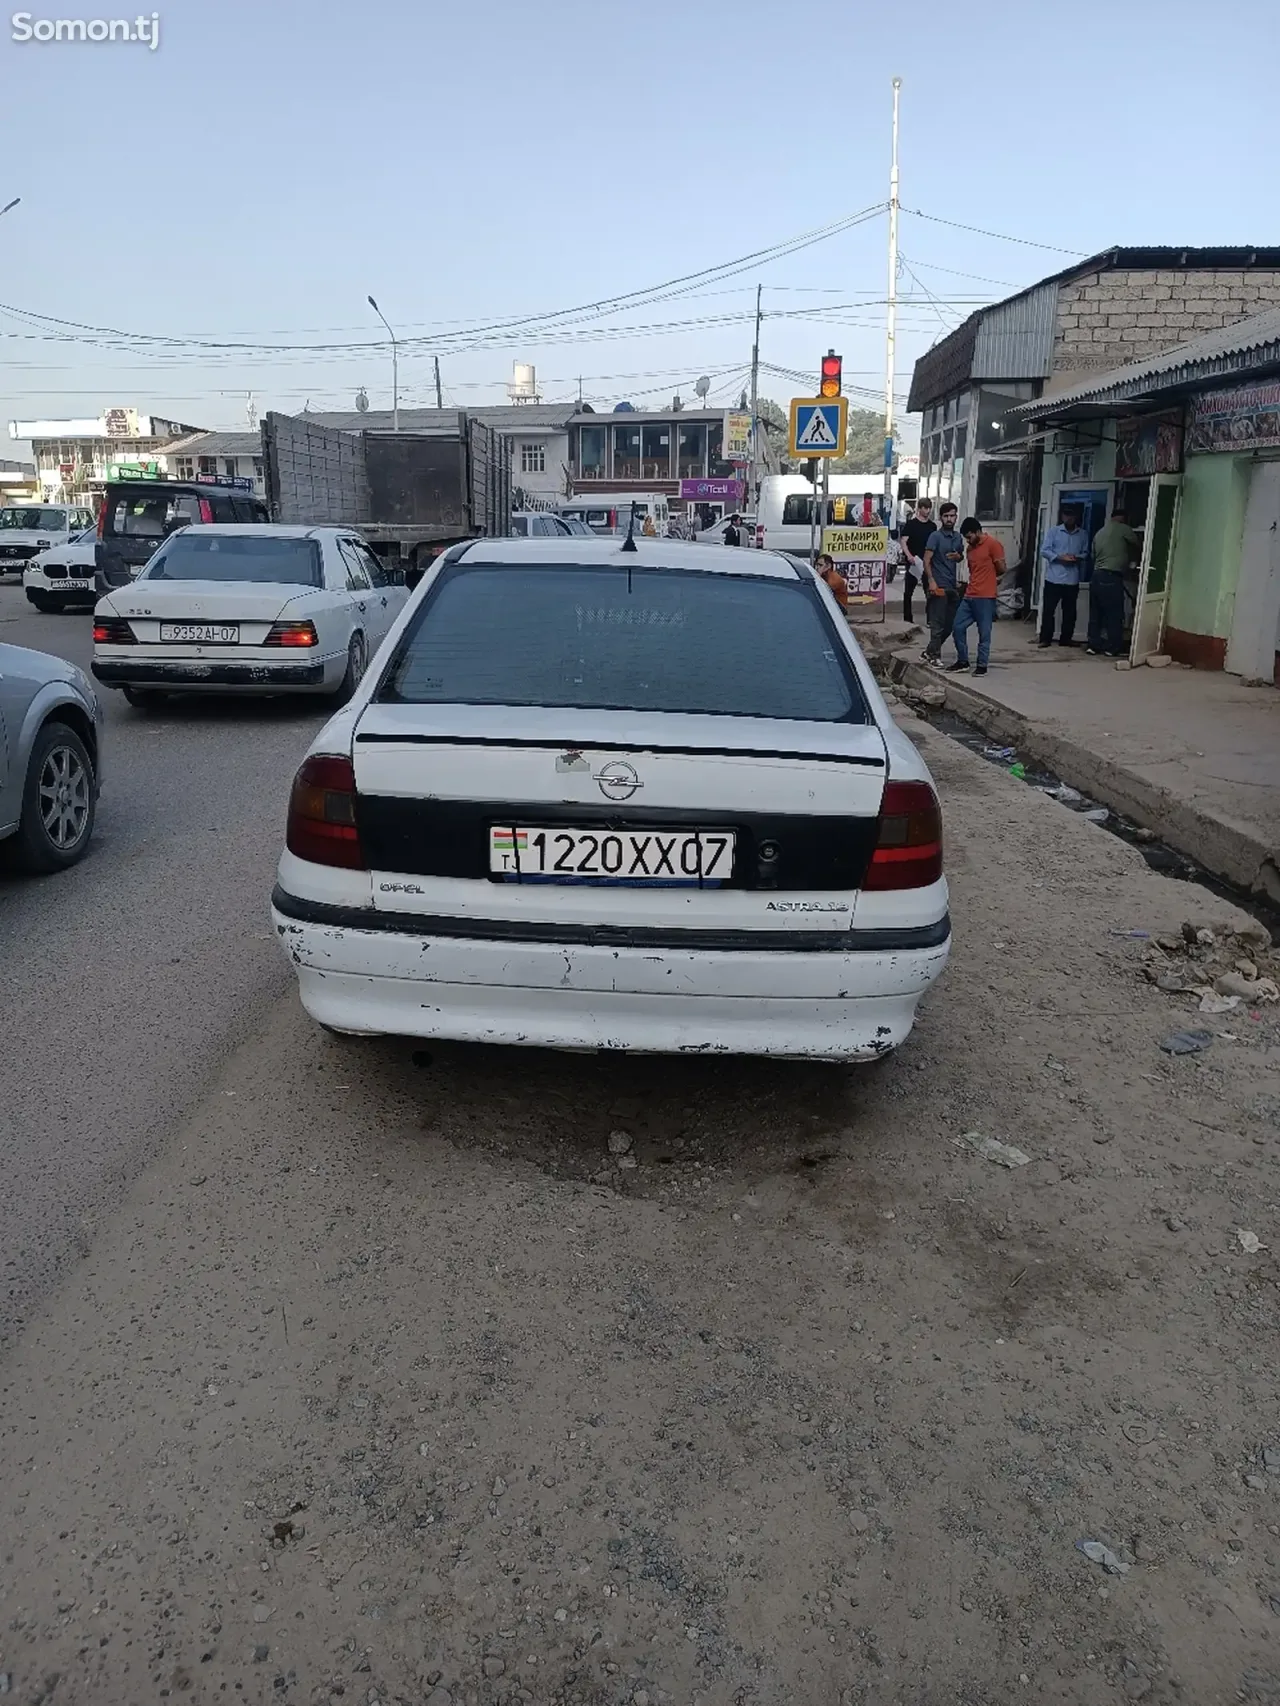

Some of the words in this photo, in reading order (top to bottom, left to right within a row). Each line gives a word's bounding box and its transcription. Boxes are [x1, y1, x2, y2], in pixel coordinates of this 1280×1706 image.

[532, 832, 728, 876] 1220XX07
[380, 882, 425, 894] OPEL
[766, 901, 823, 912] ASTRA
